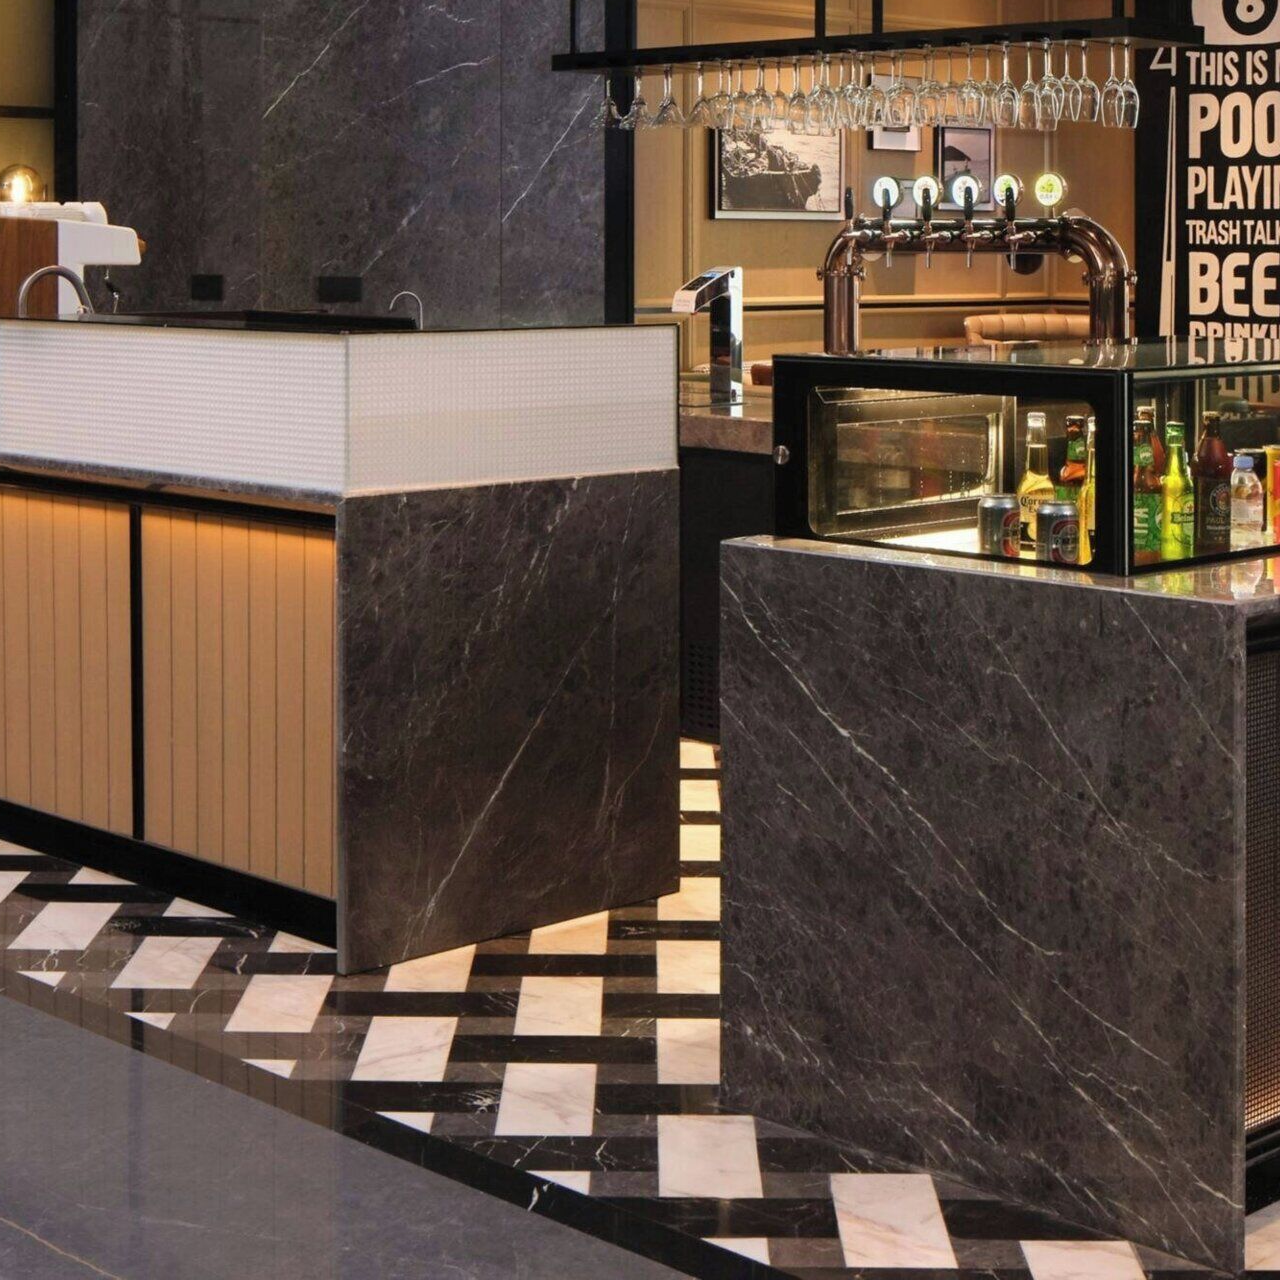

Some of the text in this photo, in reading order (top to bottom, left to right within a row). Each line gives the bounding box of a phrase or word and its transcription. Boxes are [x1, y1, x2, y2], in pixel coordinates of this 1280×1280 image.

[1186, 50, 1238, 87] THIS
[1246, 48, 1268, 85] IS
[1186, 220, 1241, 245] TRASH
